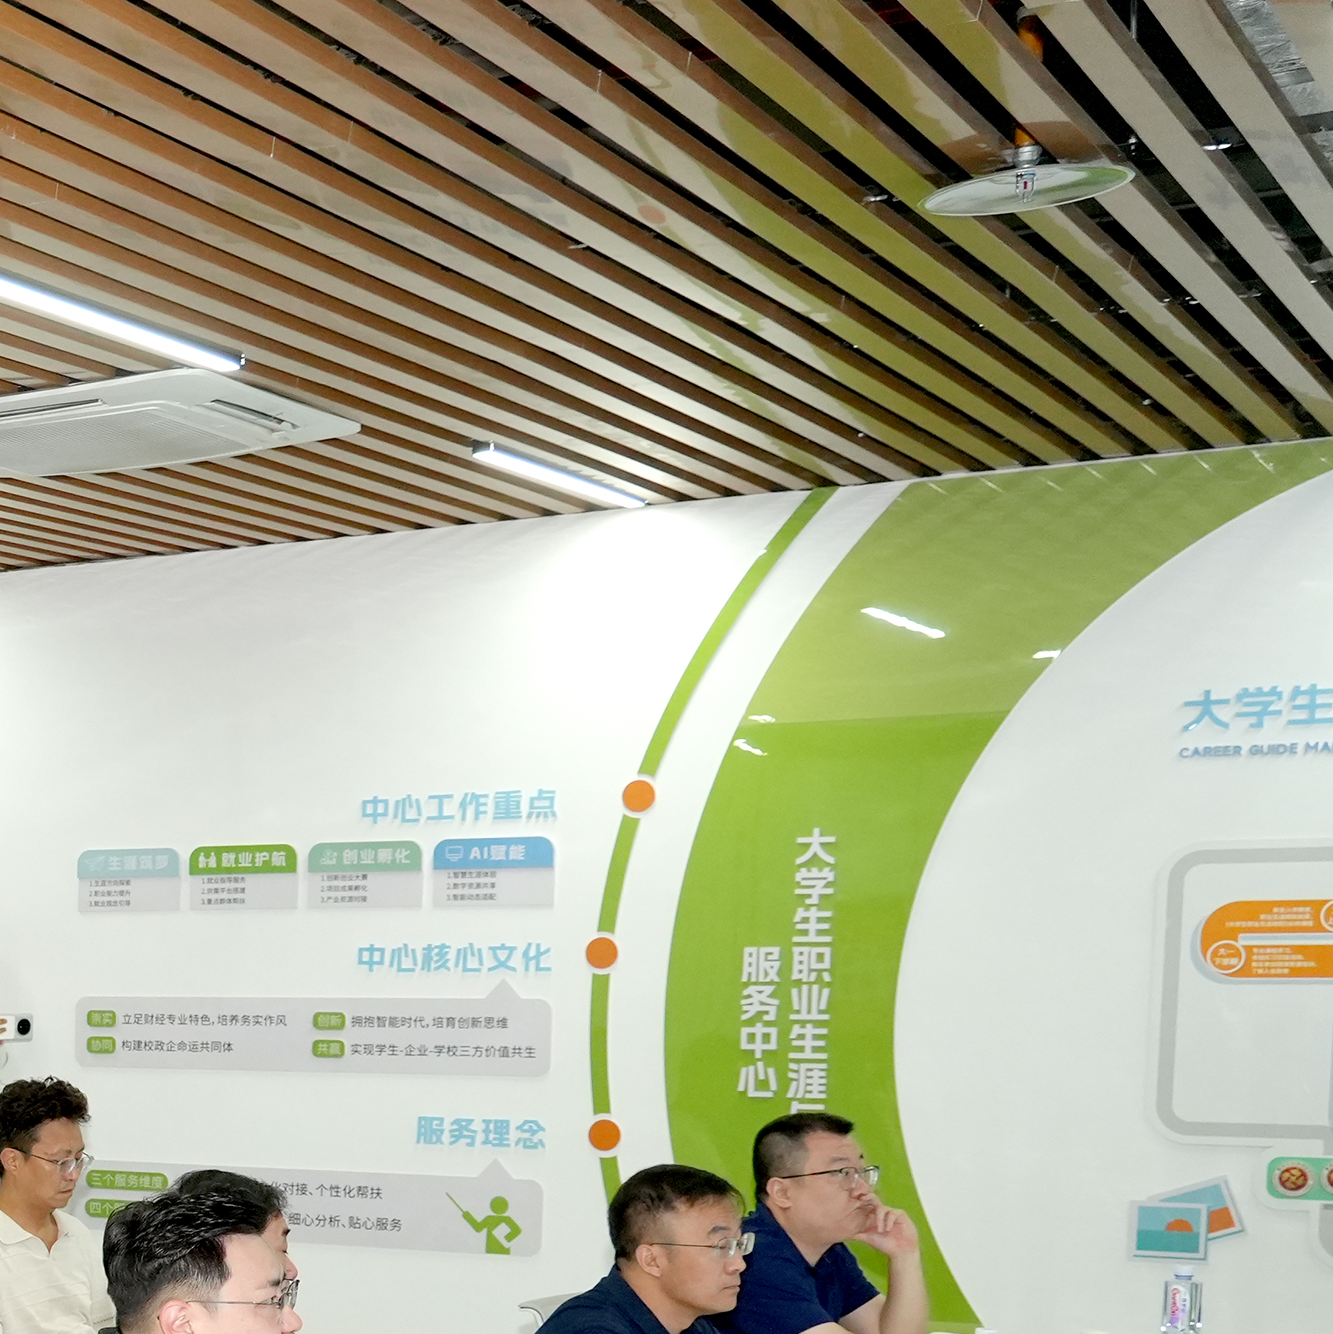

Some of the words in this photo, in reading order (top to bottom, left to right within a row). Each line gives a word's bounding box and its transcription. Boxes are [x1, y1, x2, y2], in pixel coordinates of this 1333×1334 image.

[1182, 684, 1333, 732] 大学生
[1179, 745, 1242, 758] CAREER
[1249, 743, 1298, 756] GUIDE
[1304, 741, 1333, 755] MA
[361, 789, 557, 825] 中心工作重点
[221, 851, 287, 867] 就业护航
[342, 847, 411, 865] 创业孵化
[469, 844, 526, 861] AI赋能
[358, 943, 552, 973] 中心核心文化
[737, 947, 781, 1098] 服务中心
[121, 1040, 234, 1053] 构建校政企命运共同体
[416, 1116, 547, 1149] 服务理念
[91, 1173, 164, 1188] 三个服务维度
